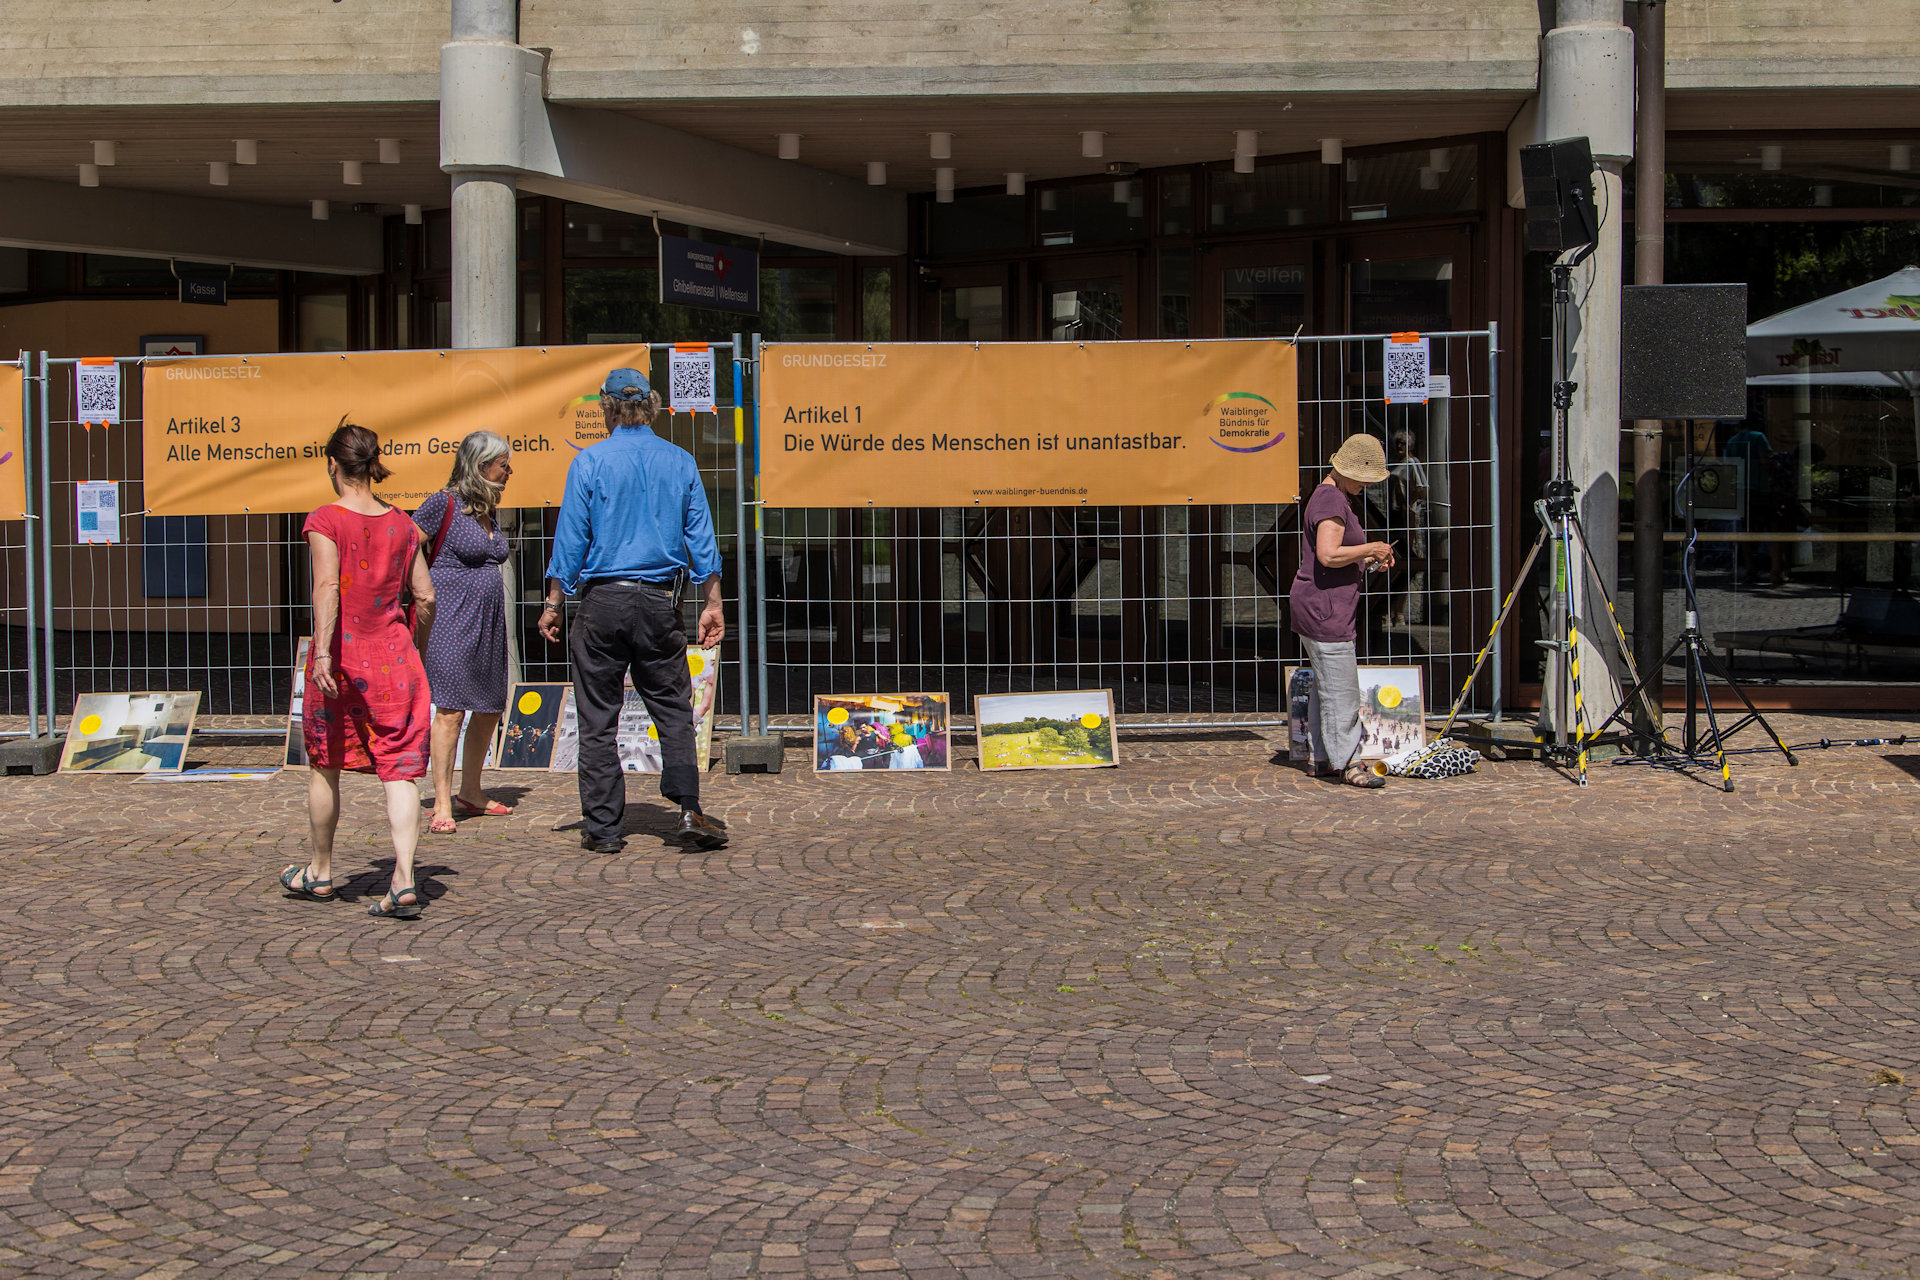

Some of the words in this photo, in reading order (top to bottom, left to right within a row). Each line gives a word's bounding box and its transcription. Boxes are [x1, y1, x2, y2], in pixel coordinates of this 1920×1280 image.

[1234, 267, 1304, 284] Welfen
[190, 282, 216, 295] Kasse
[719, 286, 748, 302] Welfensaal
[783, 354, 887, 368] GRUNDGESETZ
[166, 365, 261, 381] GRUNDGESETZ
[784, 405, 848, 424] Artikel
[854, 405, 862, 424] 1
[1220, 407, 1268, 418] Waiblinger
[166, 416, 226, 435] Artikel
[230, 416, 240, 434] 3
[1219, 418, 1255, 427] Bündnis
[1257, 418, 1270, 426] für
[575, 430, 610, 440] Demokr
[1219, 428, 1270, 438] Demokratie
[166, 444, 200, 462] Alle
[207, 442, 297, 461] Menschen
[303, 440, 328, 458] sin
[383, 438, 421, 455] dem
[427, 437, 460, 454] Ges
[507, 434, 555, 452] leich.
[784, 434, 815, 452] Die
[821, 433, 885, 452] Würde
[892, 433, 925, 451] des
[932, 433, 1030, 451] Menschen
[1037, 433, 1060, 450] ist
[1066, 431, 1186, 451] unantastbar.
[972, 486, 1088, 498] www.waiblinger-buendnis.de
